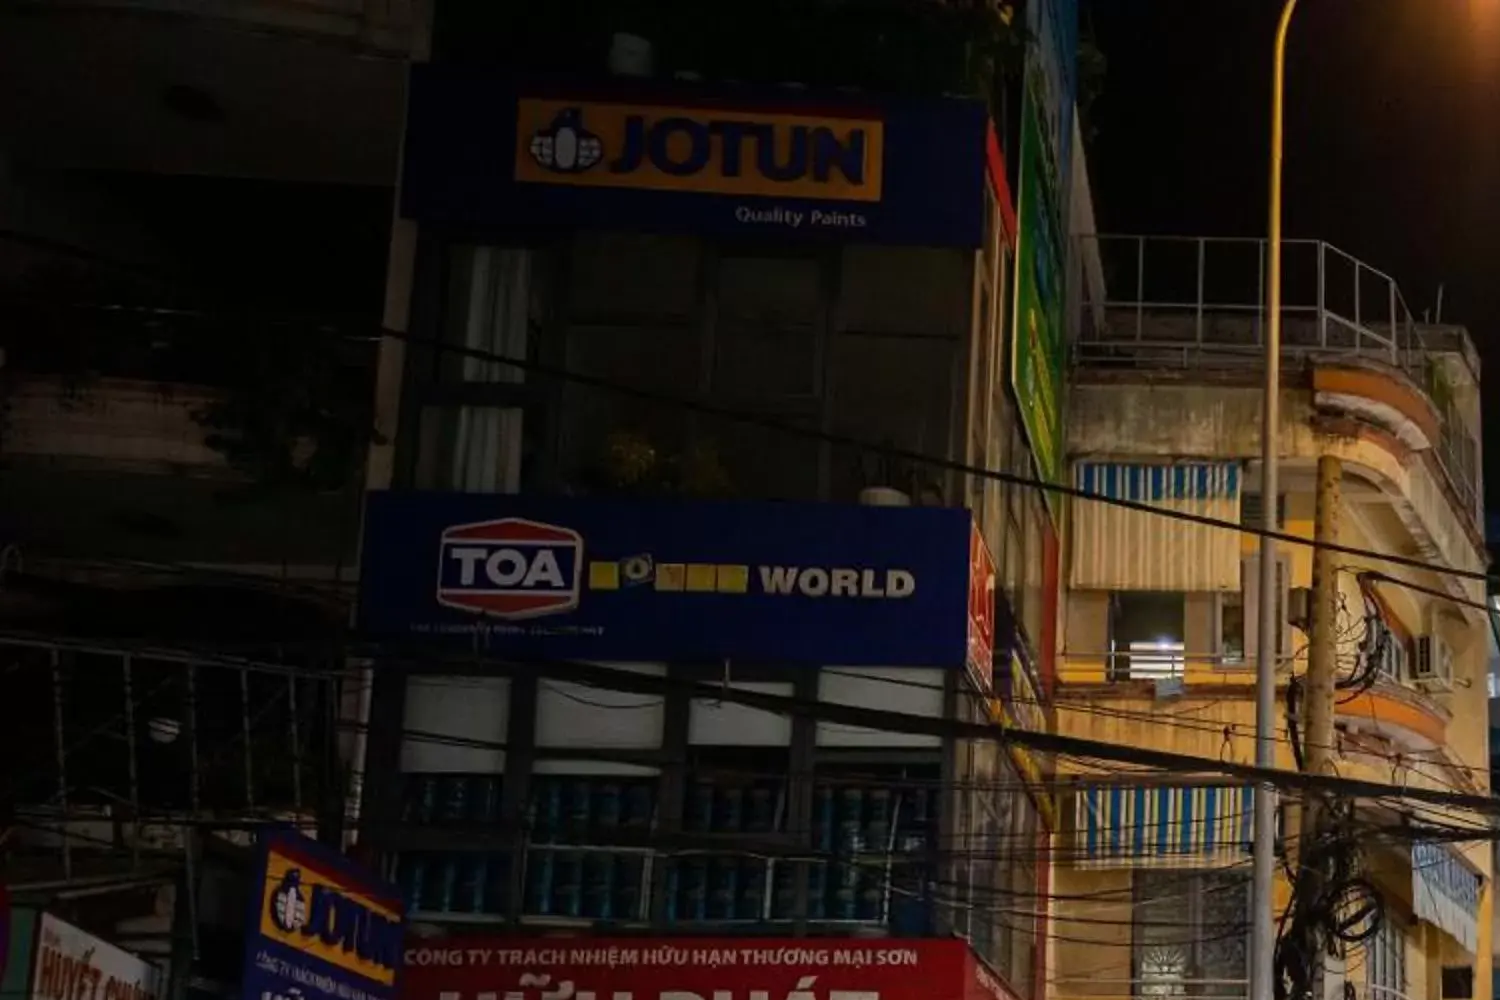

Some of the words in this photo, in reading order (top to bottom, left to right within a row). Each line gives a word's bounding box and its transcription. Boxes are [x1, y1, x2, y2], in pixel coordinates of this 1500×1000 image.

[611, 115, 865, 186] JOTUN
[734, 204, 803, 228] Quality
[811, 208, 867, 228] Paints
[450, 547, 566, 588] TOA
[758, 565, 916, 599] WORLD
[467, 949, 492, 966] TY
[569, 945, 640, 969] NHIỆM
[641, 944, 689, 966] HỮU
[692, 948, 738, 968] HẠN
[740, 947, 829, 966] THƯƠNG
[833, 948, 872, 969] MẠI
[875, 948, 918, 966] SƠN
